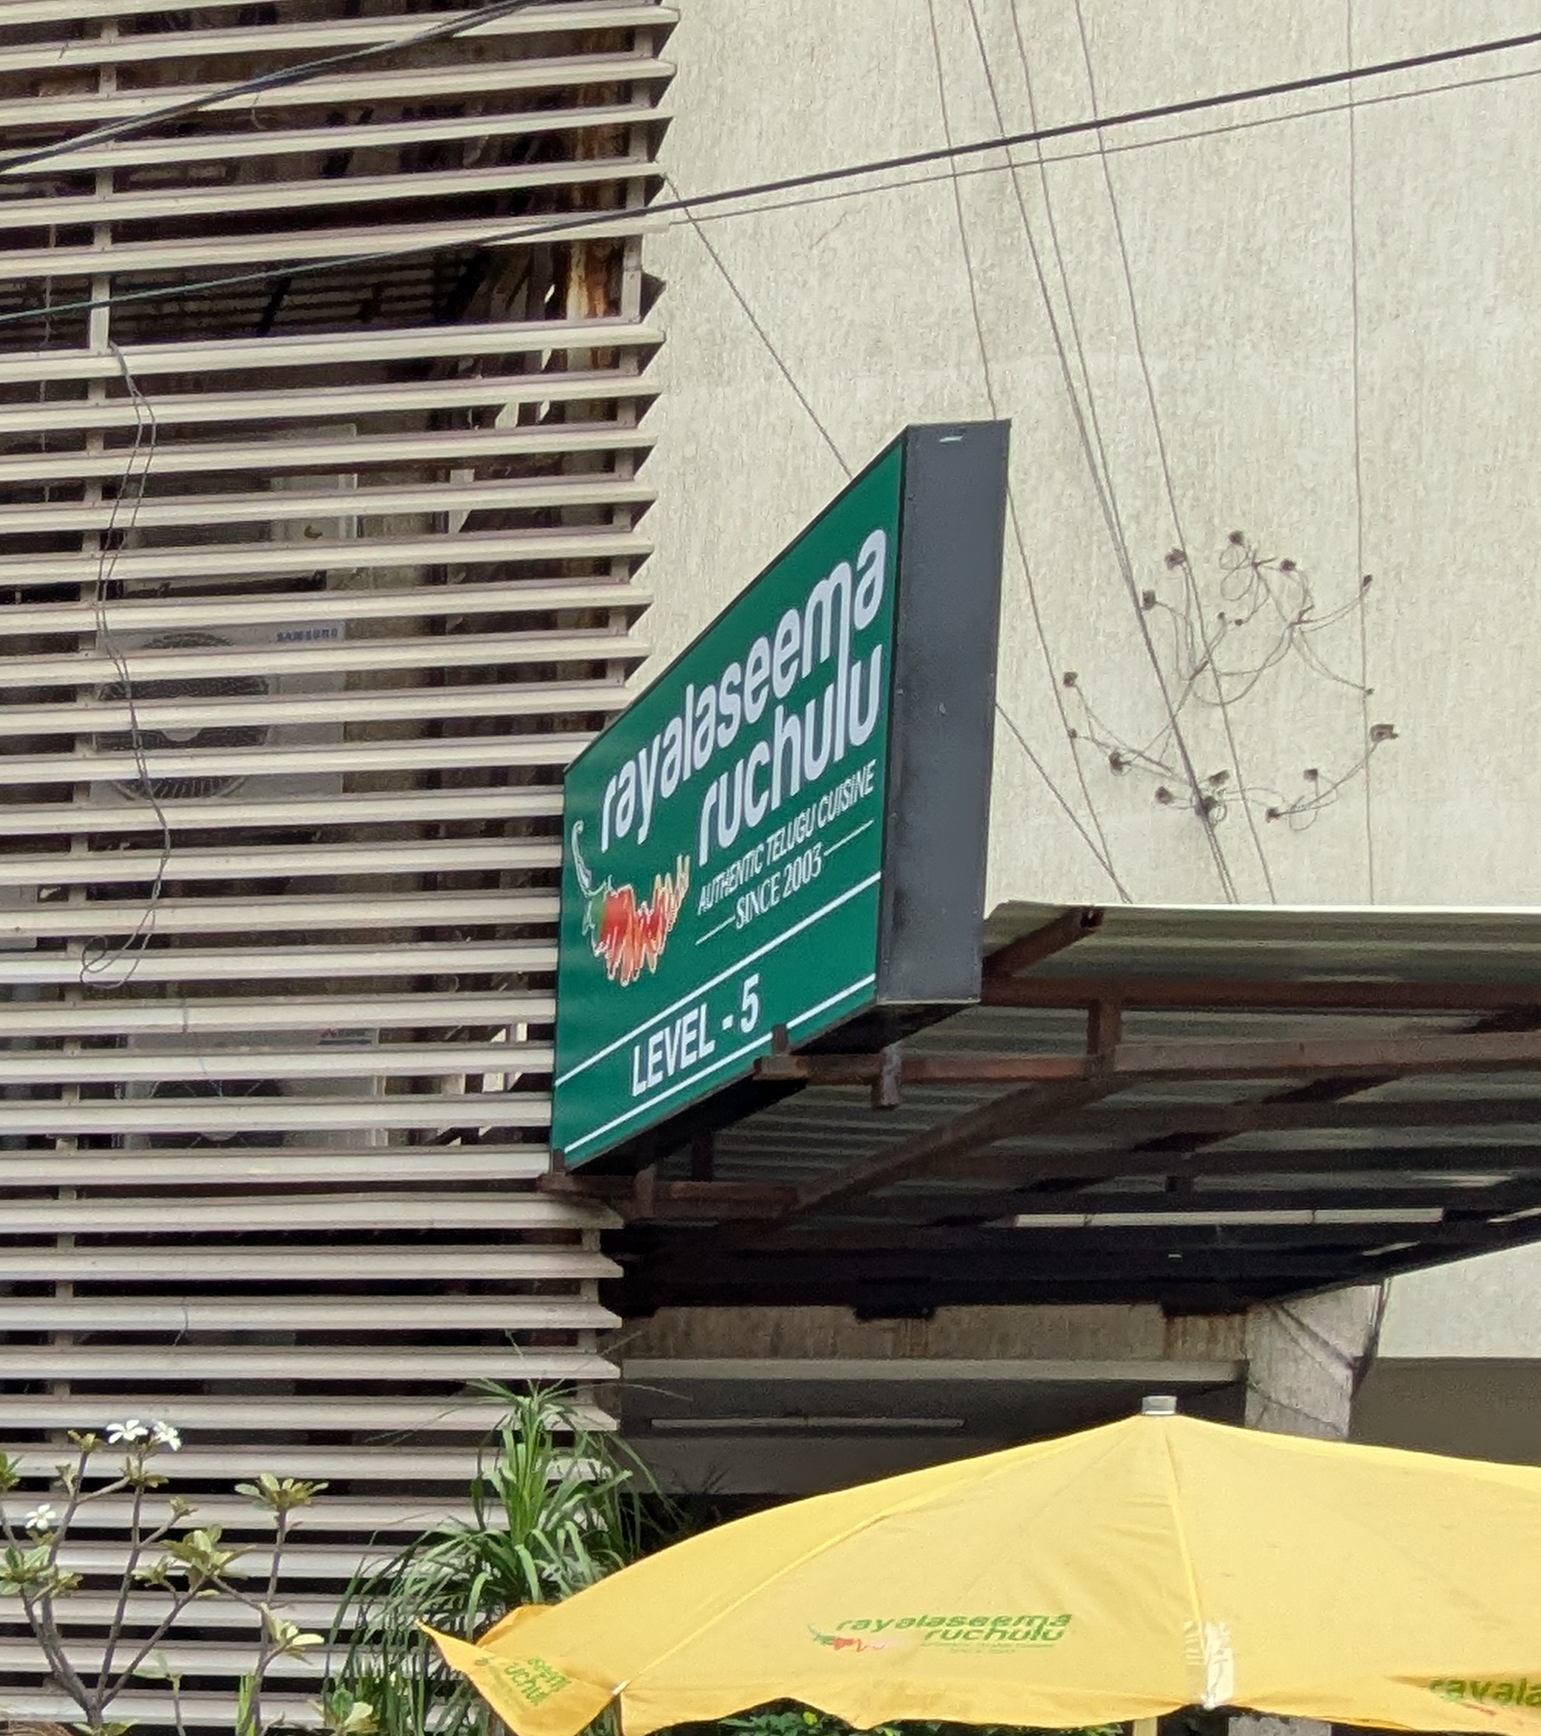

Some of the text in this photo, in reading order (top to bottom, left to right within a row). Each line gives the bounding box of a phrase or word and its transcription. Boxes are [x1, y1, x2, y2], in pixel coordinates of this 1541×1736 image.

[602, 529, 887, 852] rayalaseema
[699, 644, 883, 867] ruchulu
[697, 759, 877, 917] AUTHENTIC TELUGU CUISINE
[736, 841, 823, 931] SINCE 2003
[632, 1002, 716, 1097] LEVEL
[740, 972, 760, 1033] 5
